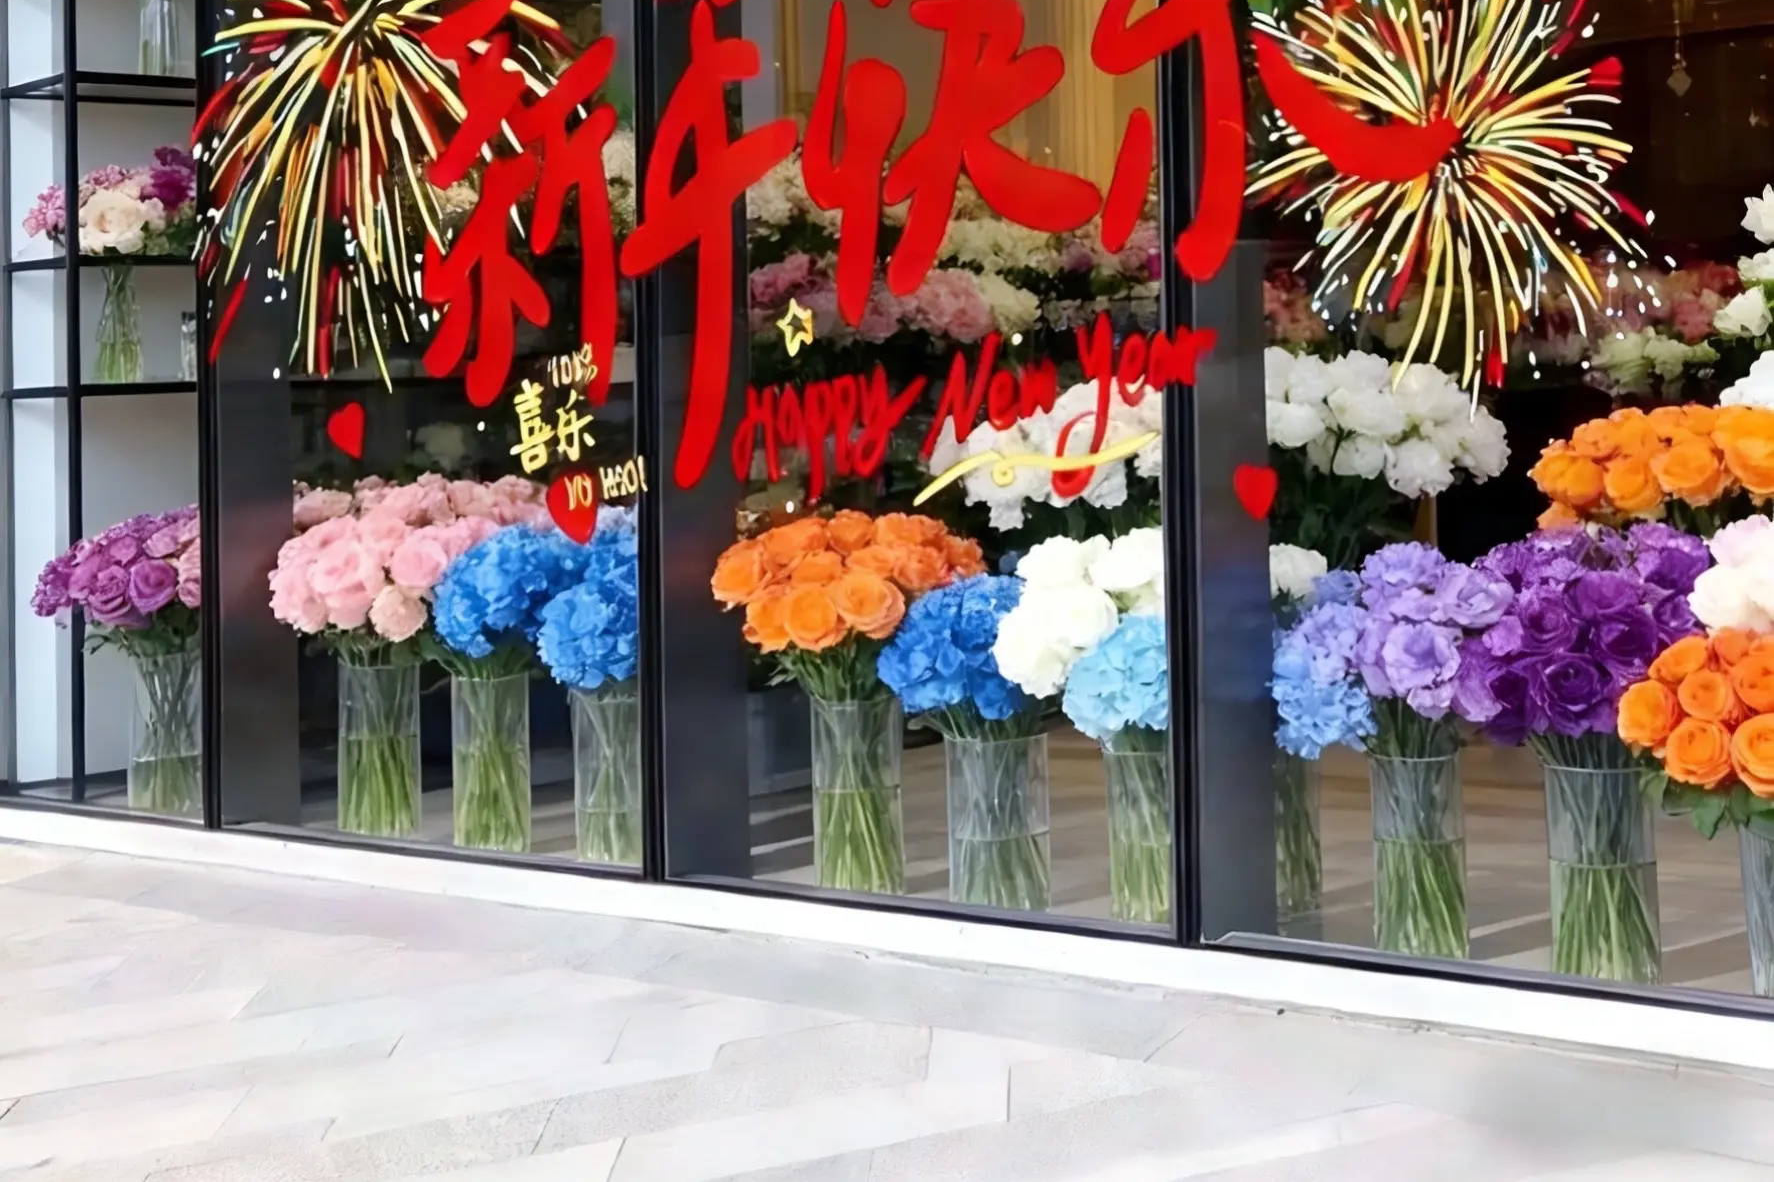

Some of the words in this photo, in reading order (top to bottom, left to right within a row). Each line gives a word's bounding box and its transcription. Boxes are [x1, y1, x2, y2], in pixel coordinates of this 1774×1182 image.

[509, 378, 596, 474] 喜乐
[731, 363, 928, 504] Happy
[919, 330, 1058, 463] New
[1050, 310, 1219, 499] Year
